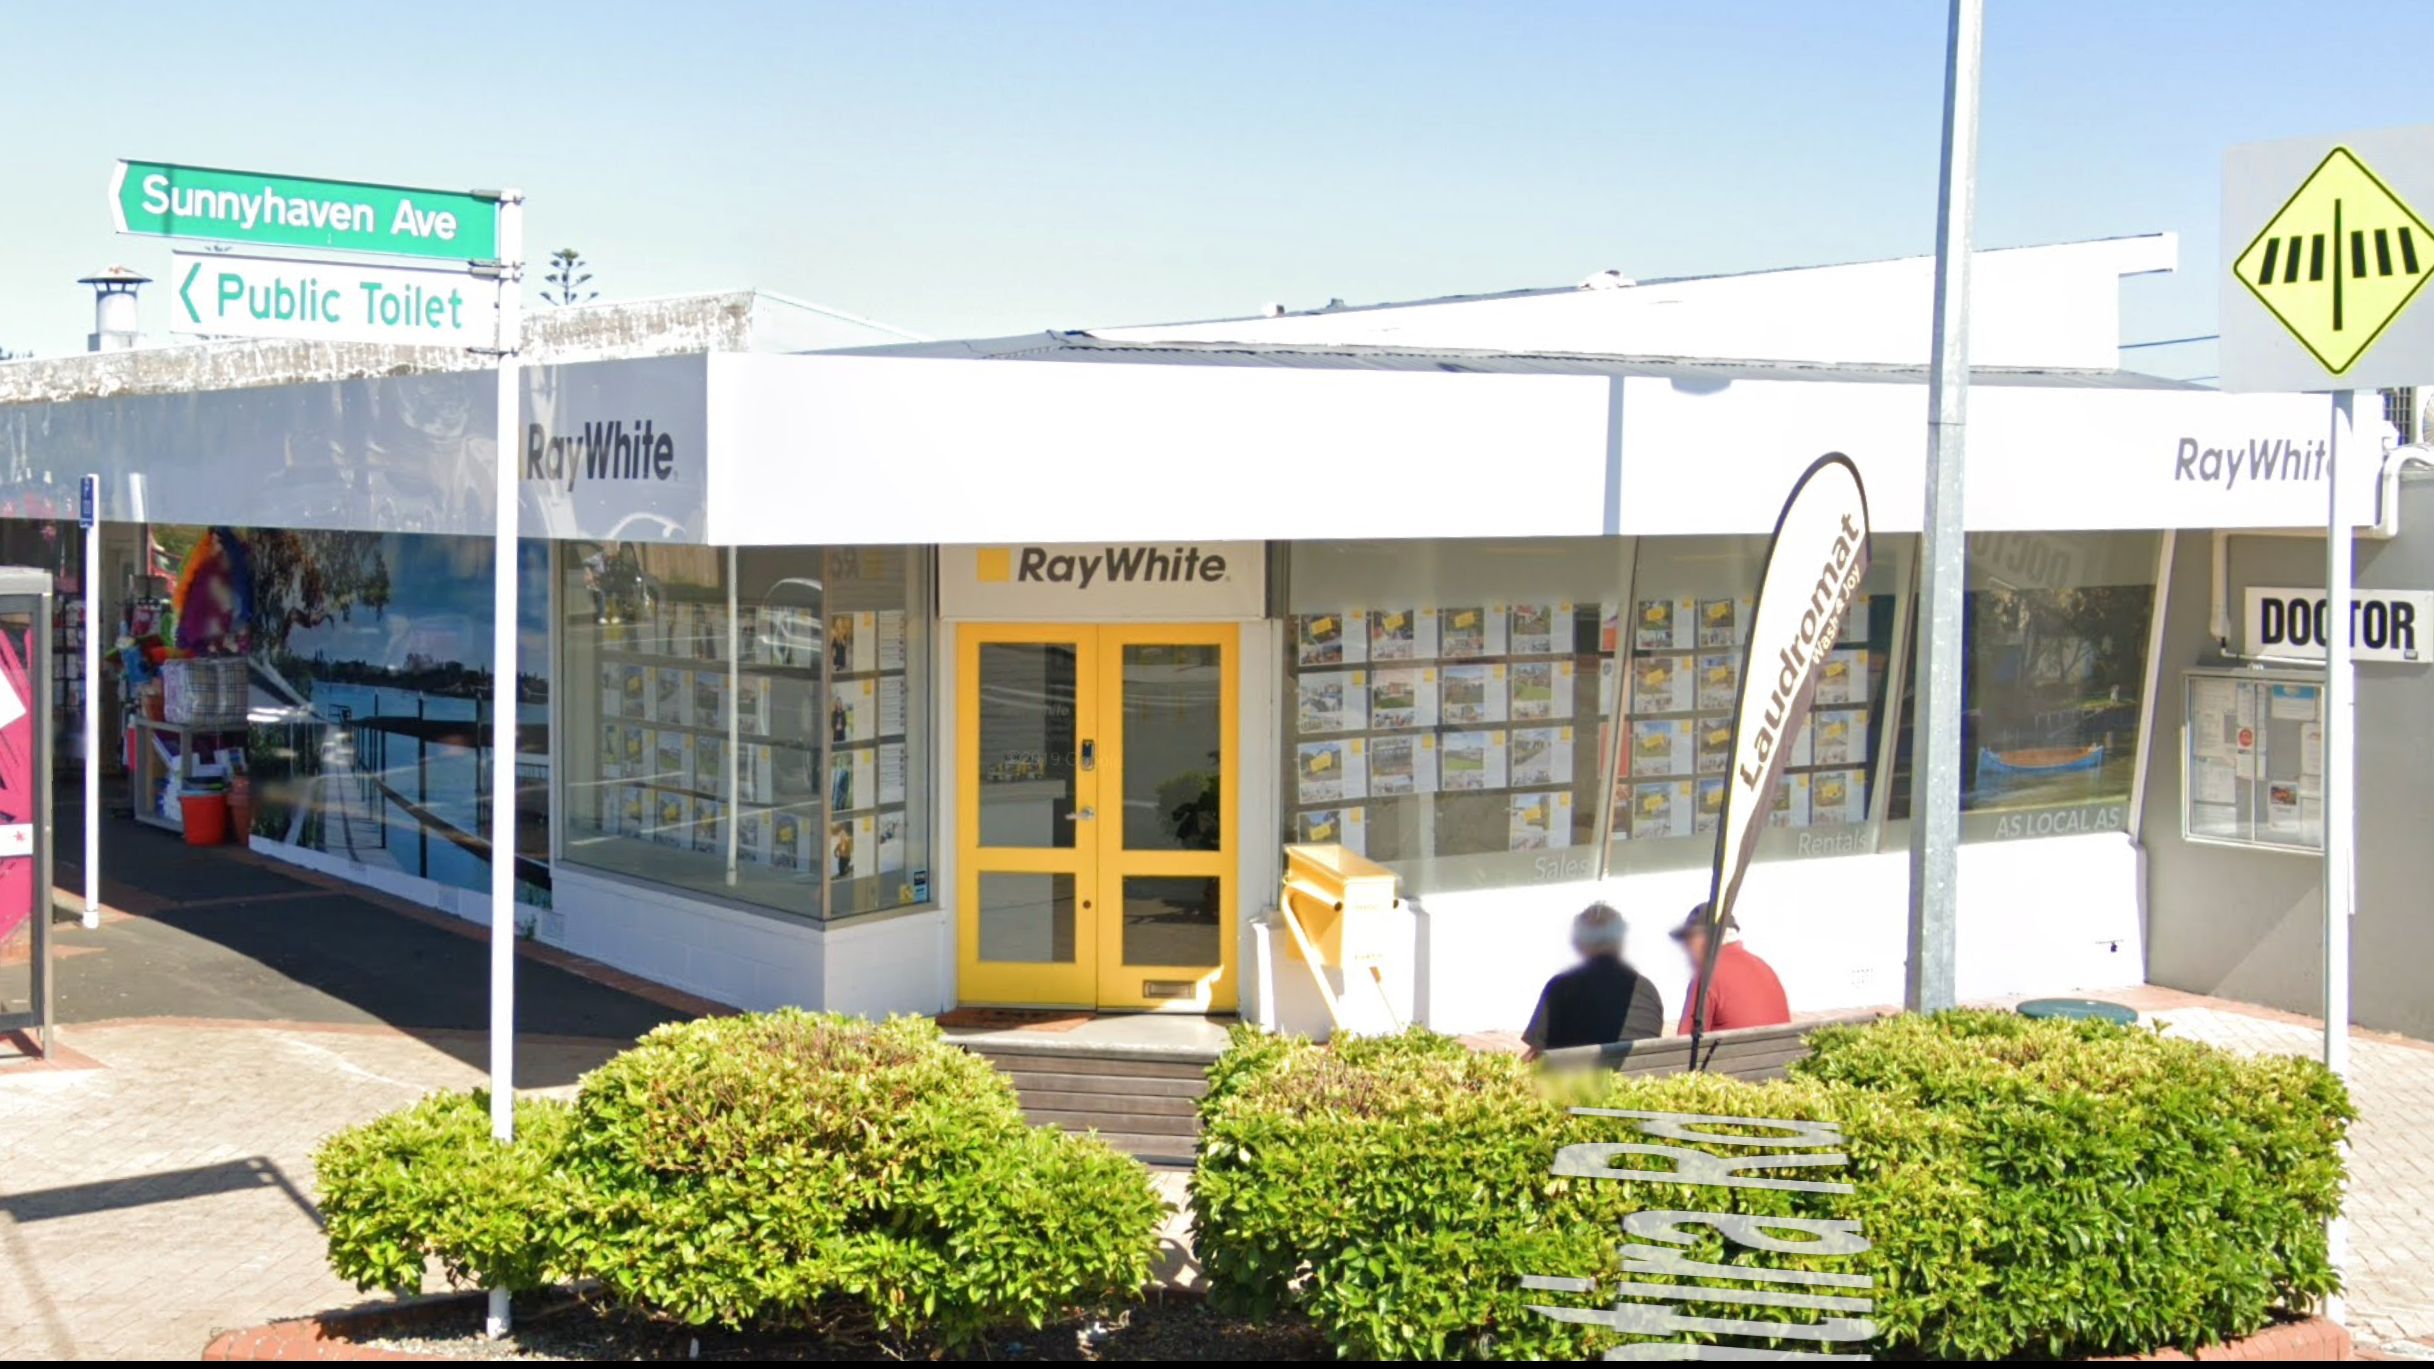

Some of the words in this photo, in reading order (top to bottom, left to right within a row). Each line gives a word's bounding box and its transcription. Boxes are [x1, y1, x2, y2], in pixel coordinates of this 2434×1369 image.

[142, 174, 374, 232] Sunnyhaven
[390, 199, 457, 240] Ave
[217, 272, 341, 323] Public
[360, 281, 463, 329] Toilet
[527, 419, 675, 493] RayWhite
[2174, 437, 2332, 491] RayWhit
[1018, 547, 1227, 589] RayWhite
[1739, 513, 1860, 792] Laudromat
[1811, 615, 1840, 665] Wash
[1798, 828, 1866, 857] Rentals
[1994, 814, 2023, 838] AS
[2025, 809, 2090, 834] LOCAL
[2089, 806, 2120, 829] AS
[1535, 851, 1591, 880] Sales
